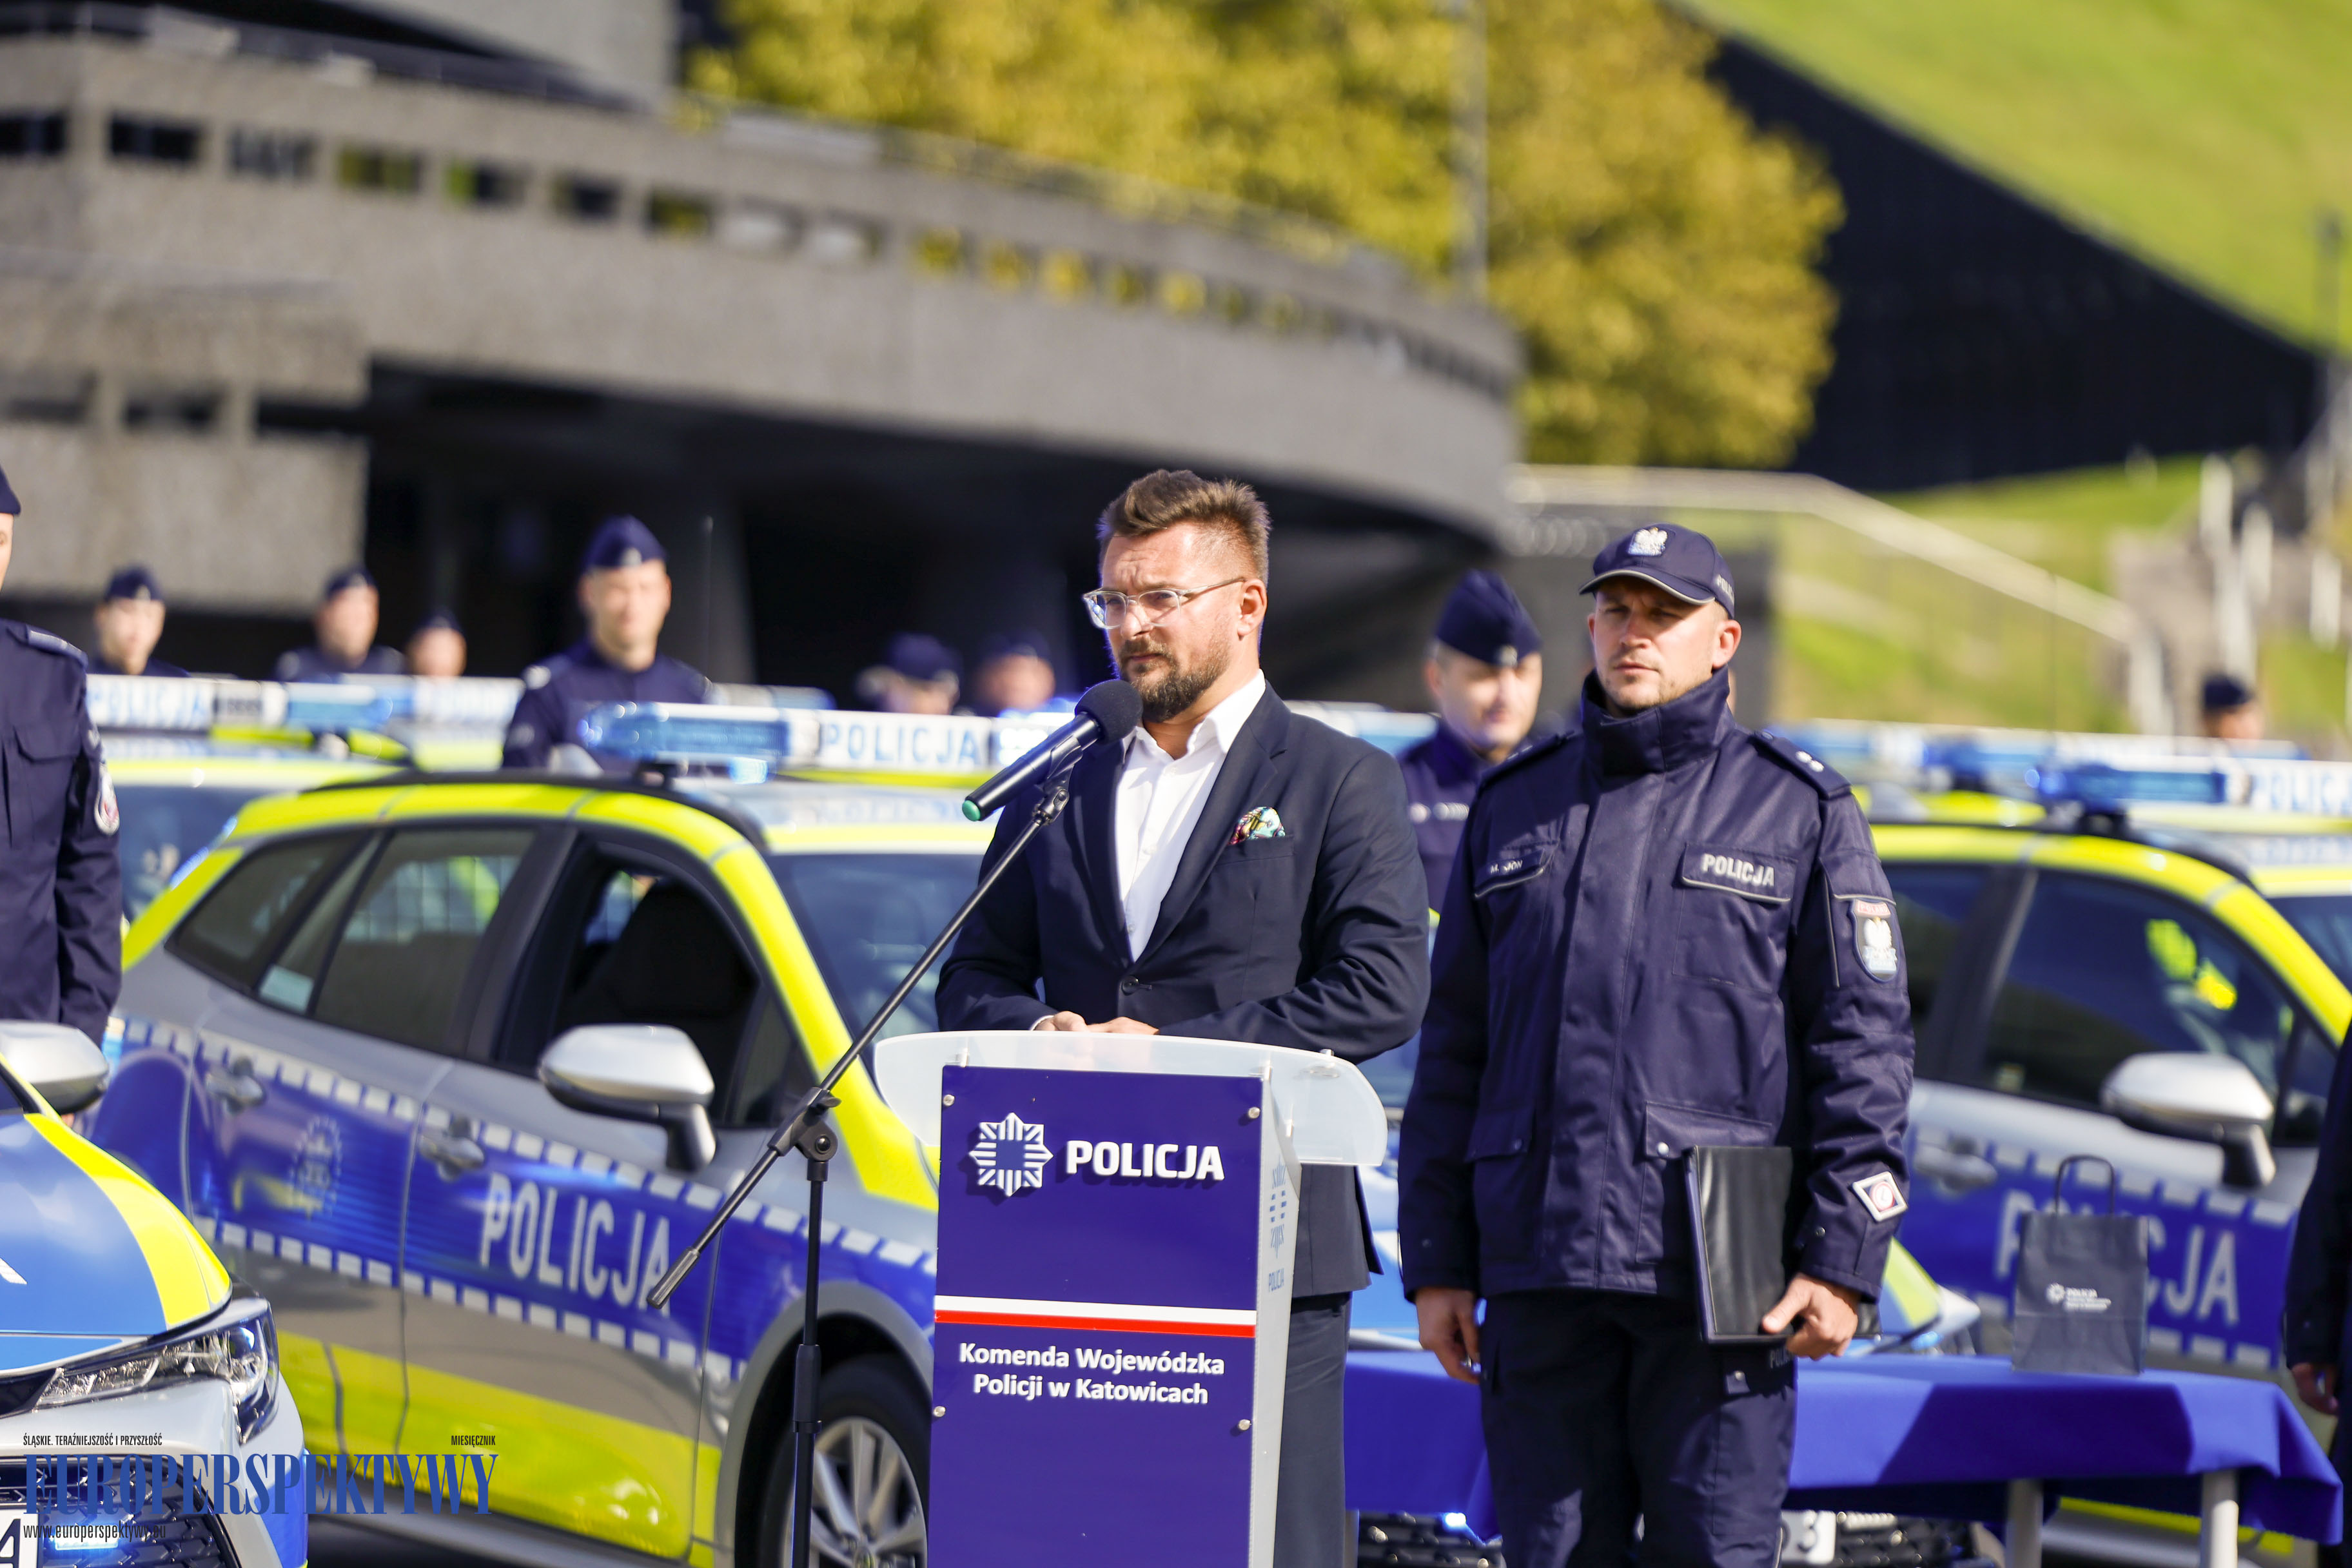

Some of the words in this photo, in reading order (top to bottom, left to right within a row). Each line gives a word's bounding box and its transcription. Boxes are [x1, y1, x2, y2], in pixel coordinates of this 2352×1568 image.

[823, 723, 981, 765] POLICJA
[1702, 853, 1775, 887] POLICJA
[1067, 1140, 1225, 1181] POLICJA
[480, 1172, 671, 1318] POLICJA
[959, 1342, 1070, 1367] Komenda
[1075, 1348, 1226, 1375] Wojewódzka
[974, 1373, 1043, 1400] Policji
[1048, 1380, 1071, 1397] w
[1075, 1378, 1208, 1404] Katowicach
